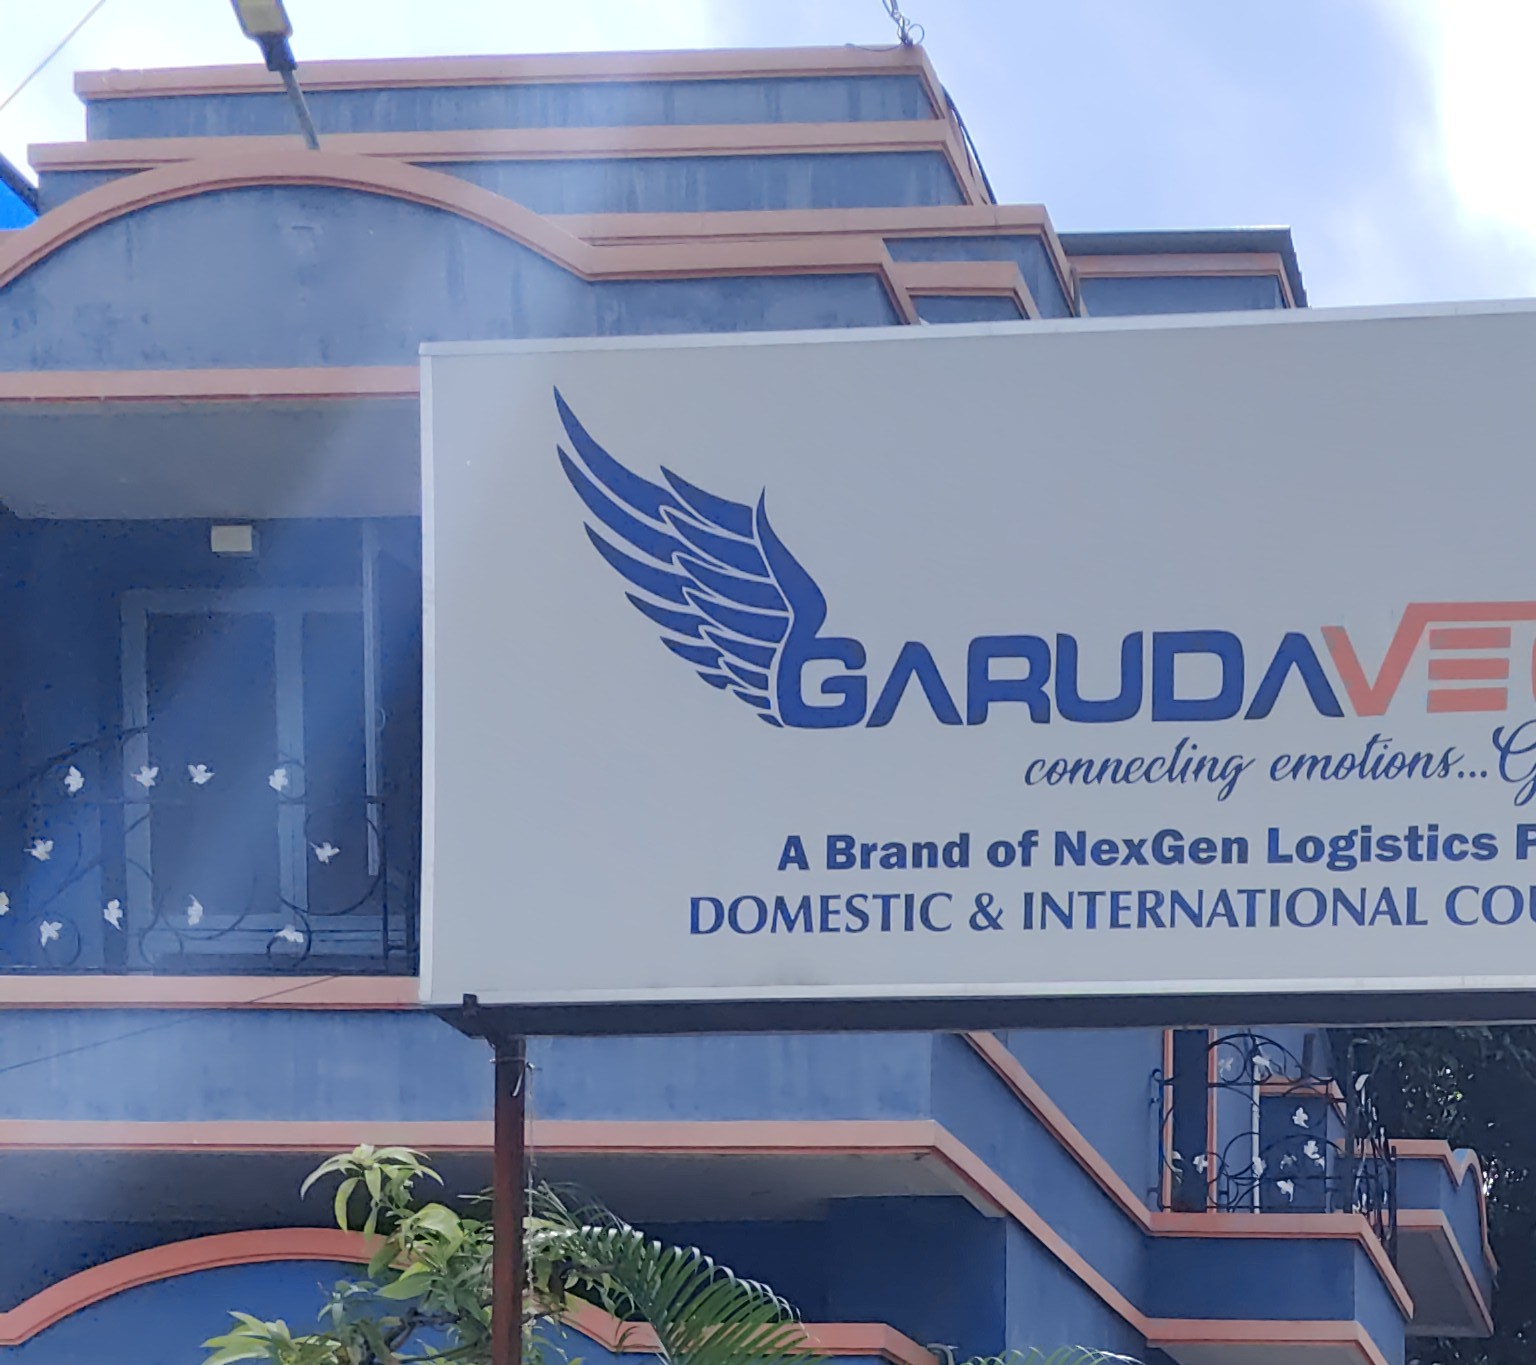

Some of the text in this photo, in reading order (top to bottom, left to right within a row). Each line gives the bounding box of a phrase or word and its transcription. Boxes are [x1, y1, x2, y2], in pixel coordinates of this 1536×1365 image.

[1023, 738, 1257, 803] connecting
[777, 833, 810, 872] A
[826, 832, 970, 871] Brand
[986, 829, 1040, 868] of
[1054, 828, 1249, 867] NexGen
[1267, 823, 1499, 872] Logistics
[689, 891, 954, 936] DOMESTIC
[968, 892, 1004, 932] &
[1023, 886, 1430, 931] INTERNATIONAL
